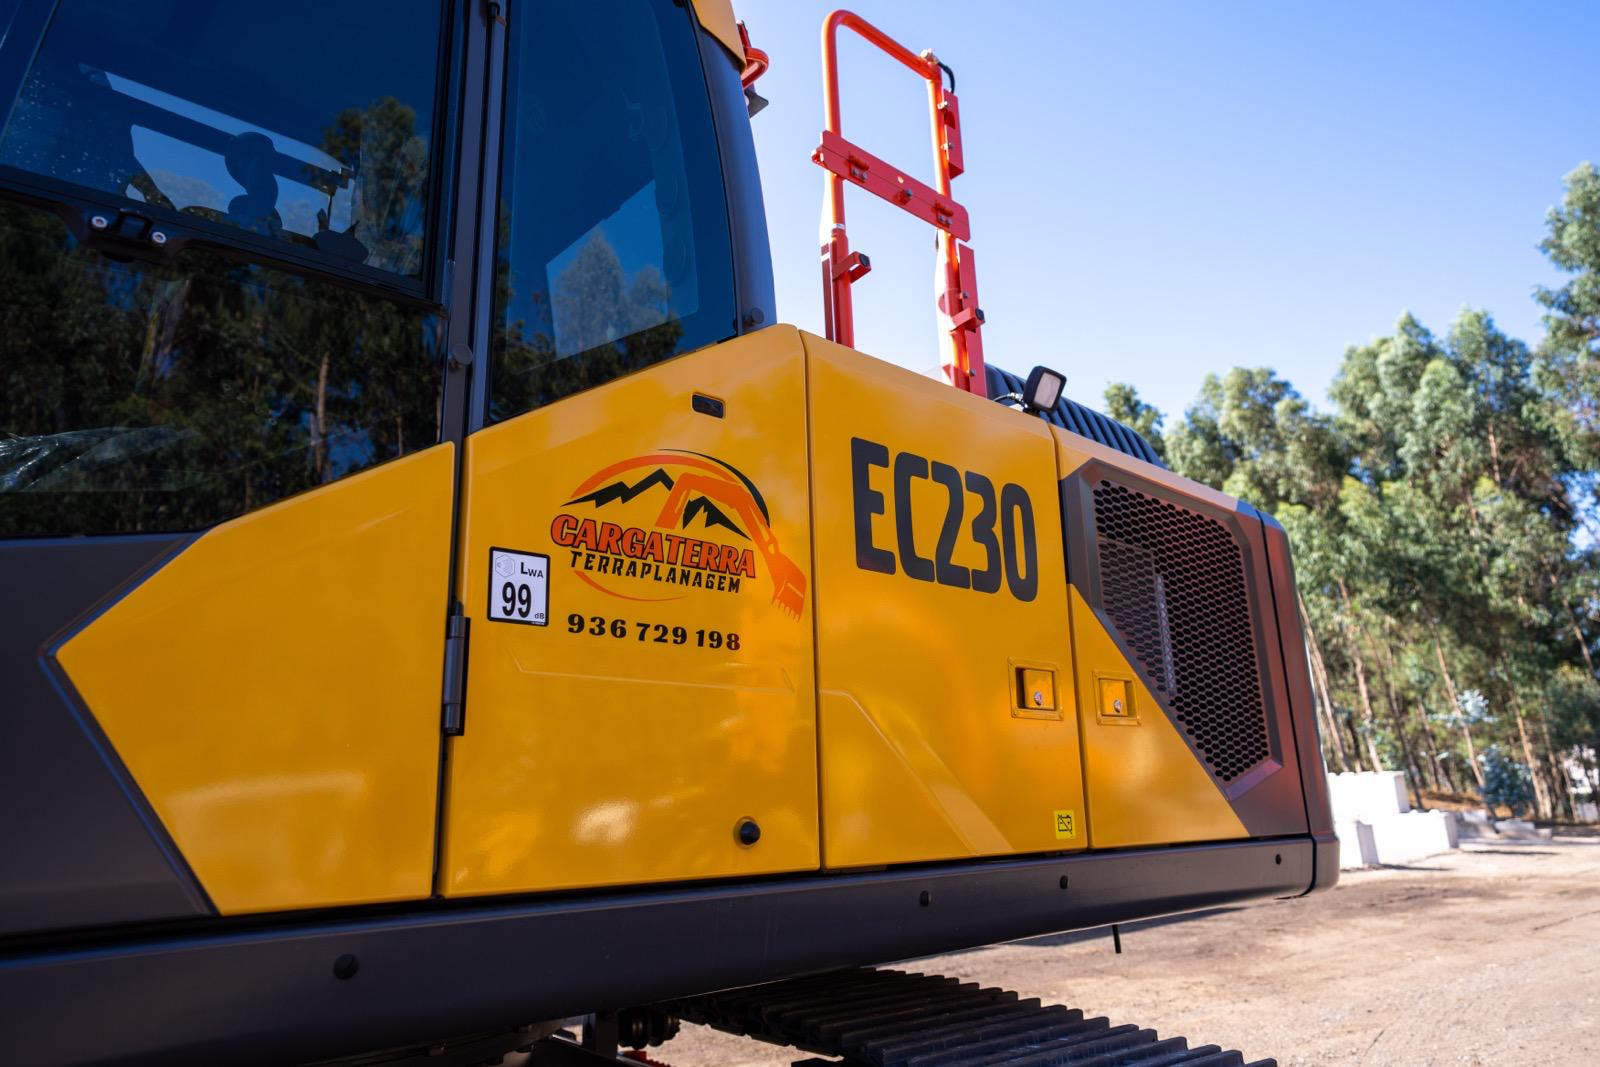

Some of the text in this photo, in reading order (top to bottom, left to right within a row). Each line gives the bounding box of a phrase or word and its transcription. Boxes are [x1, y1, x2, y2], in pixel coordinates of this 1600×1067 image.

[851, 436, 1038, 602] EC230
[550, 513, 756, 579] CARGATERRA
[570, 550, 741, 593] TERRAPLANAGEM
[502, 581, 532, 619] 99
[534, 612, 545, 620] dB
[567, 613, 741, 651] 936 729 198
